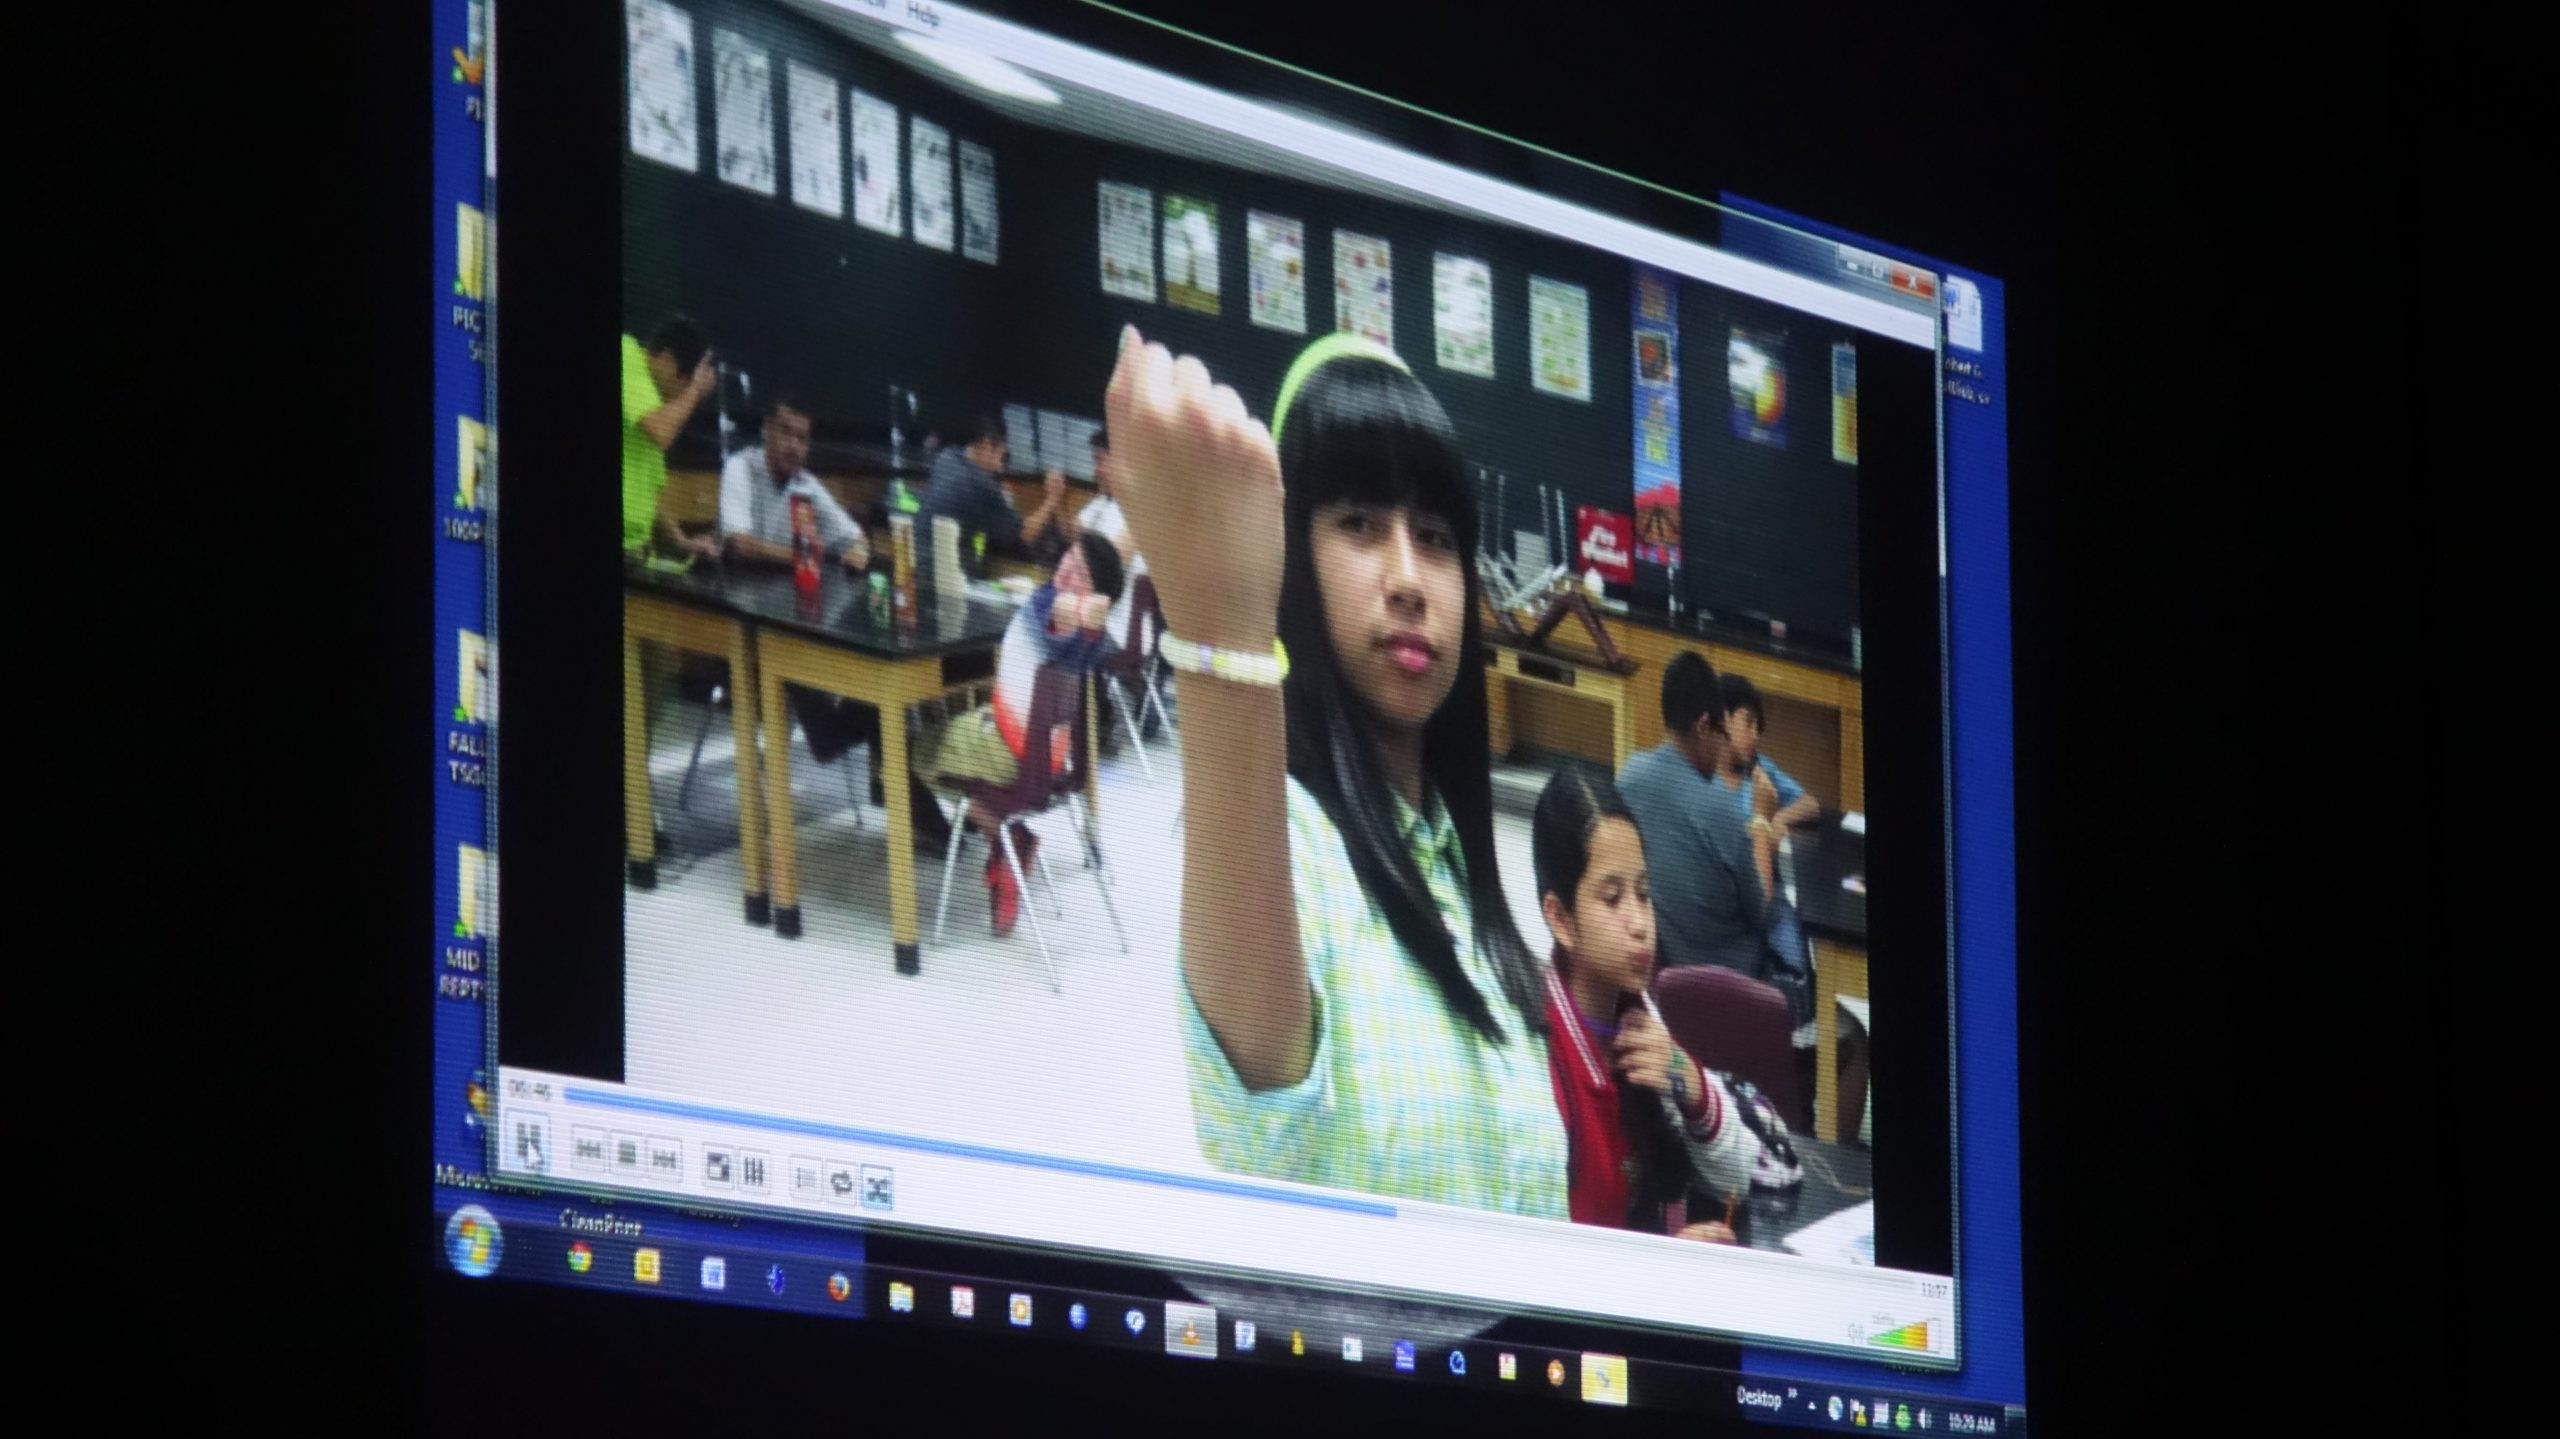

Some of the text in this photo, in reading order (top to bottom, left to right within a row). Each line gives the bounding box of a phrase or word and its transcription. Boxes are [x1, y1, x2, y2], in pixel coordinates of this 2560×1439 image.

[558, 1207, 643, 1237] CleanPrint
[1736, 1385, 1782, 1412] Desktop
[1976, 1415, 1996, 1434] AM
